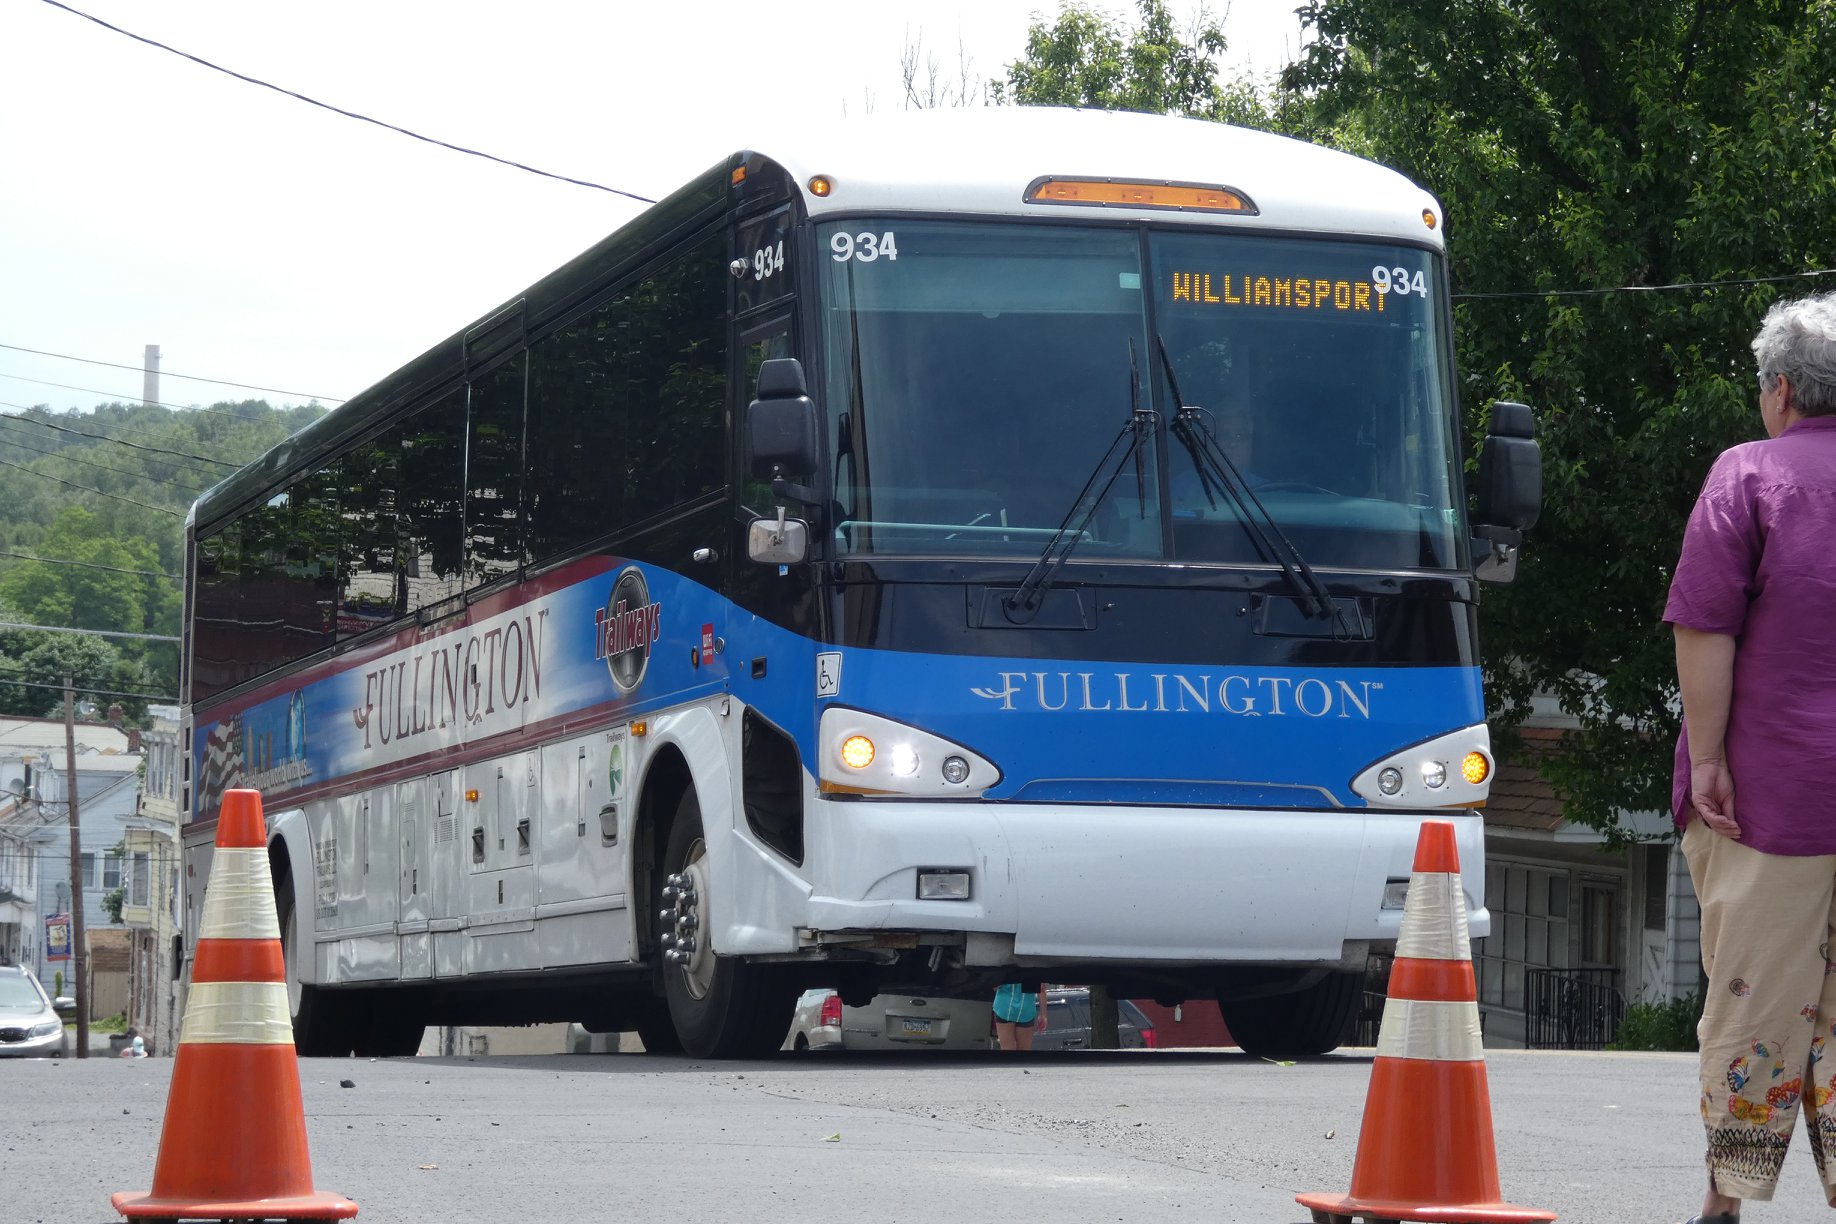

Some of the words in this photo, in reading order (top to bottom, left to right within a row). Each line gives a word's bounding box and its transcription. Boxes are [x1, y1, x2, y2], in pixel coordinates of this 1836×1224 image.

[754, 240, 784, 281] 934
[830, 231, 898, 262] 934
[1173, 272, 1387, 312] WILLIAMSPORT
[1371, 265, 1428, 298] 934
[595, 599, 661, 660] Trailways
[353, 609, 545, 749] FULLINGTON
[971, 672, 1372, 720] FULLINGTON
